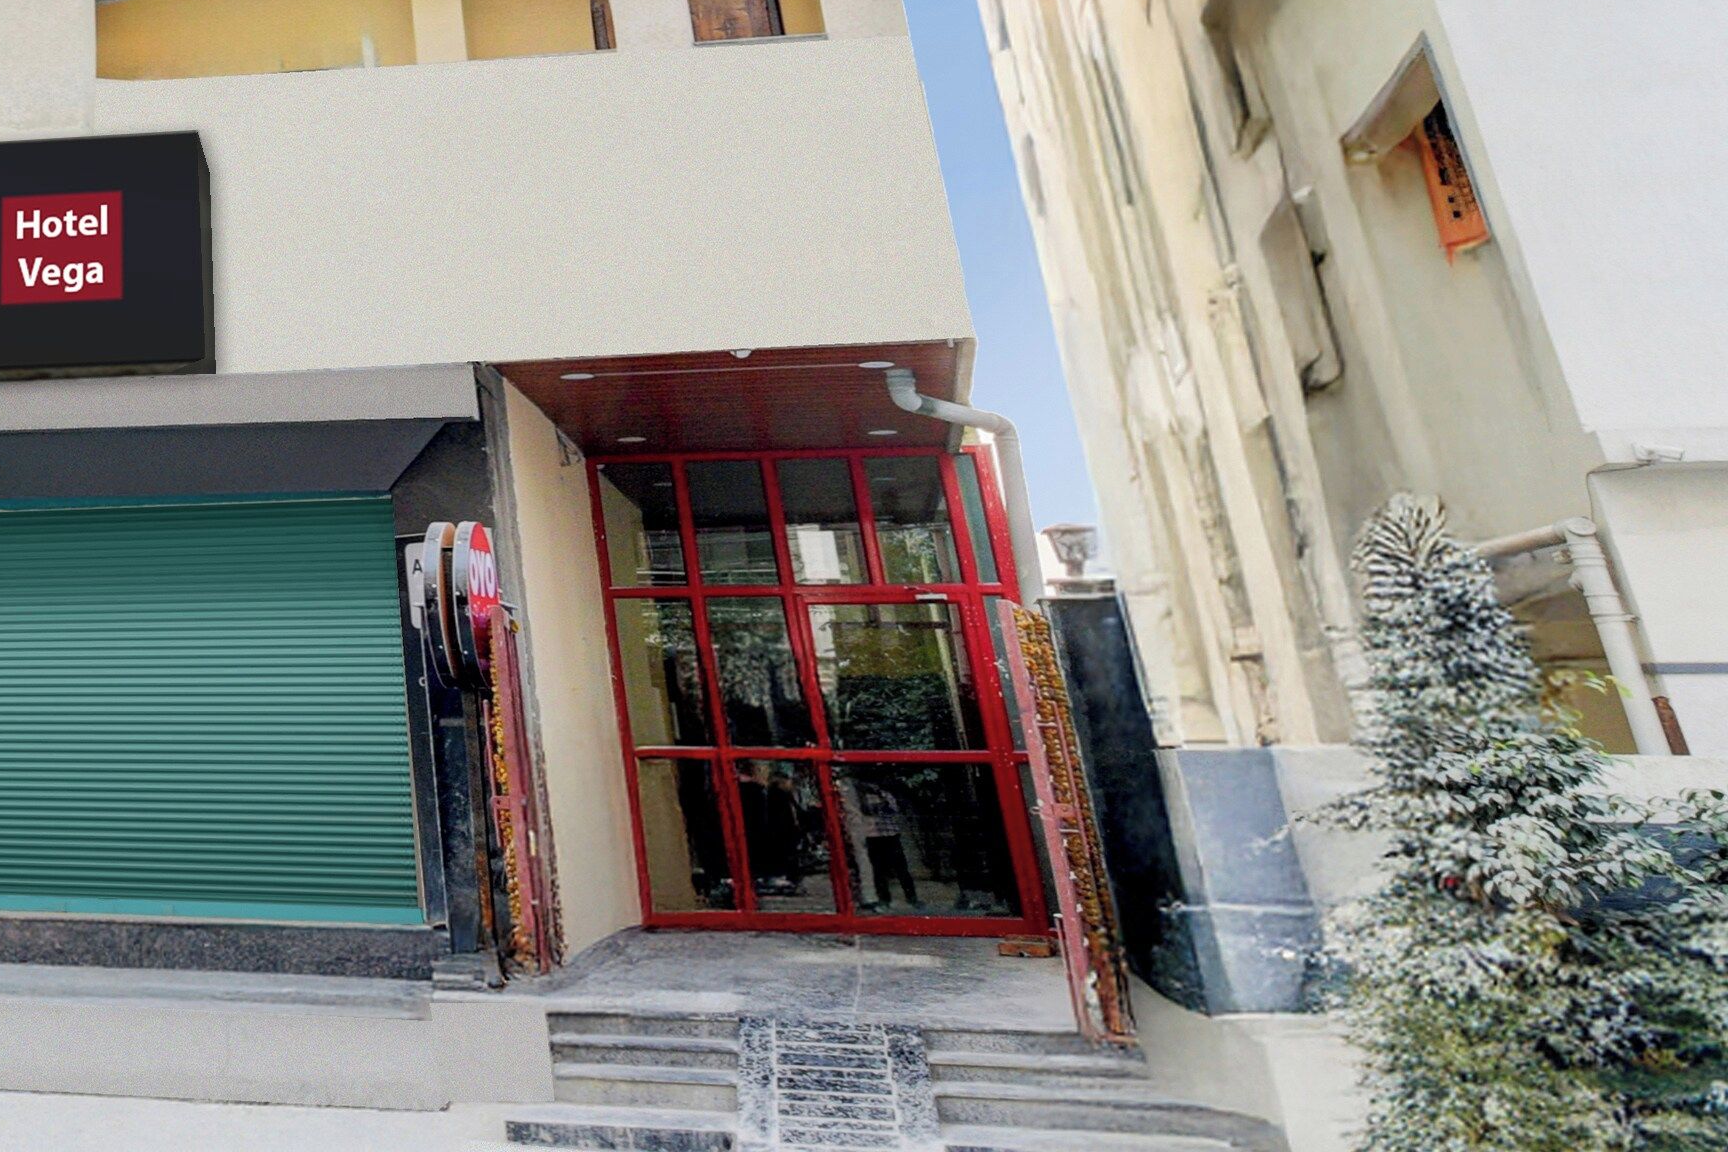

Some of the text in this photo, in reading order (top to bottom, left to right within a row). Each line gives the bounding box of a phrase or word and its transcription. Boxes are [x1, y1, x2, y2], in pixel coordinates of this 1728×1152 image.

[16, 204, 108, 240] Hotel
[17, 256, 104, 293] Vega
[469, 548, 496, 598] OYO
